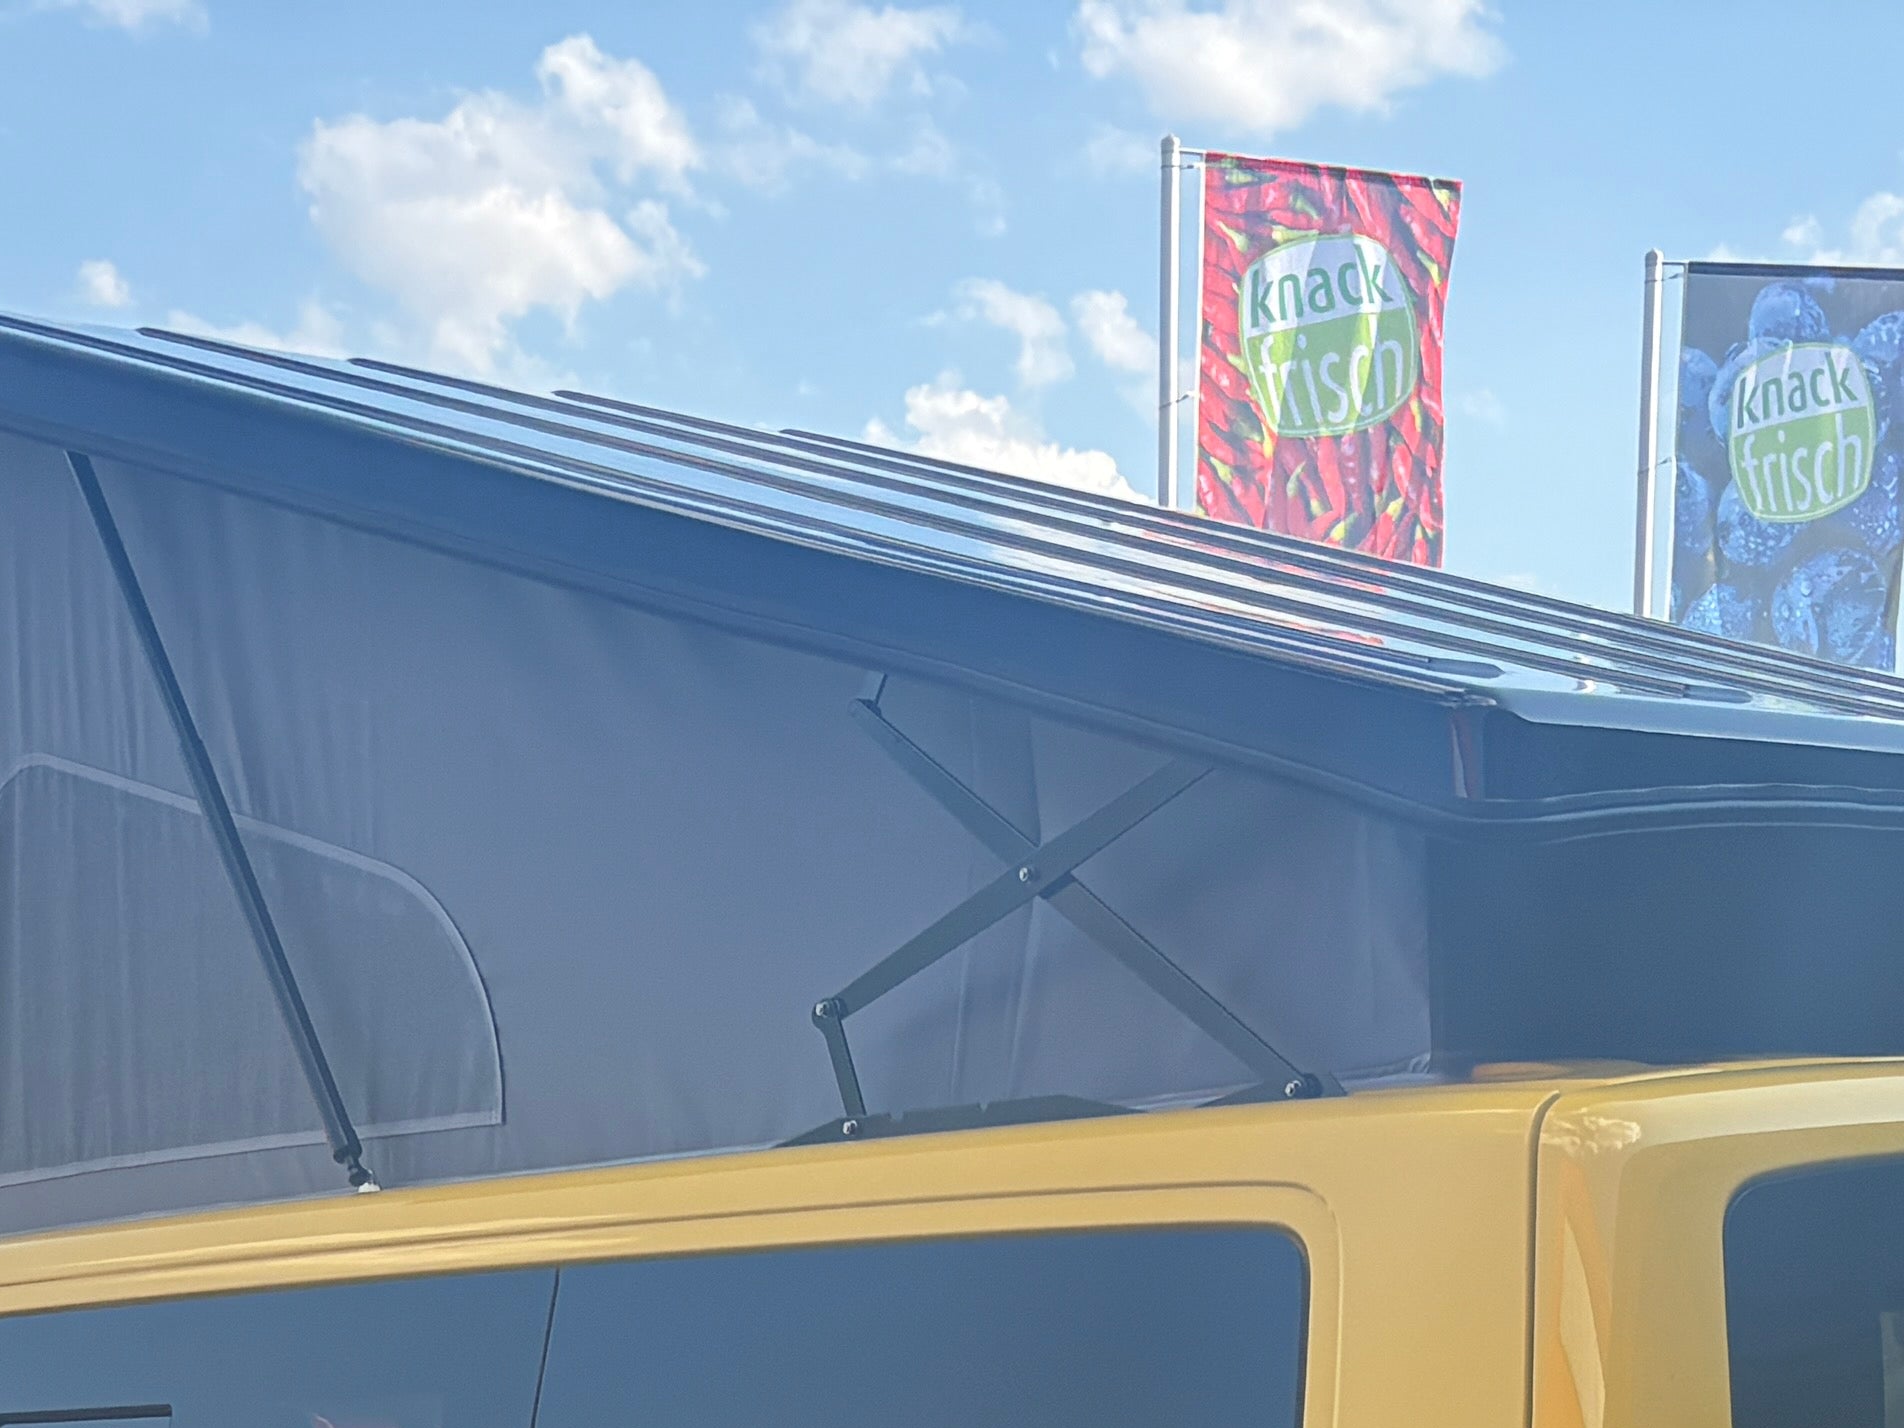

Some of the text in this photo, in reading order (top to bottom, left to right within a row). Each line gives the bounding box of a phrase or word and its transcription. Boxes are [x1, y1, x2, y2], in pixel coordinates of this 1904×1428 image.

[1250, 243, 1394, 329] knack
[1259, 313, 1404, 426] frisch
[1737, 351, 1858, 430] knack
[1741, 412, 1863, 512] frisch
